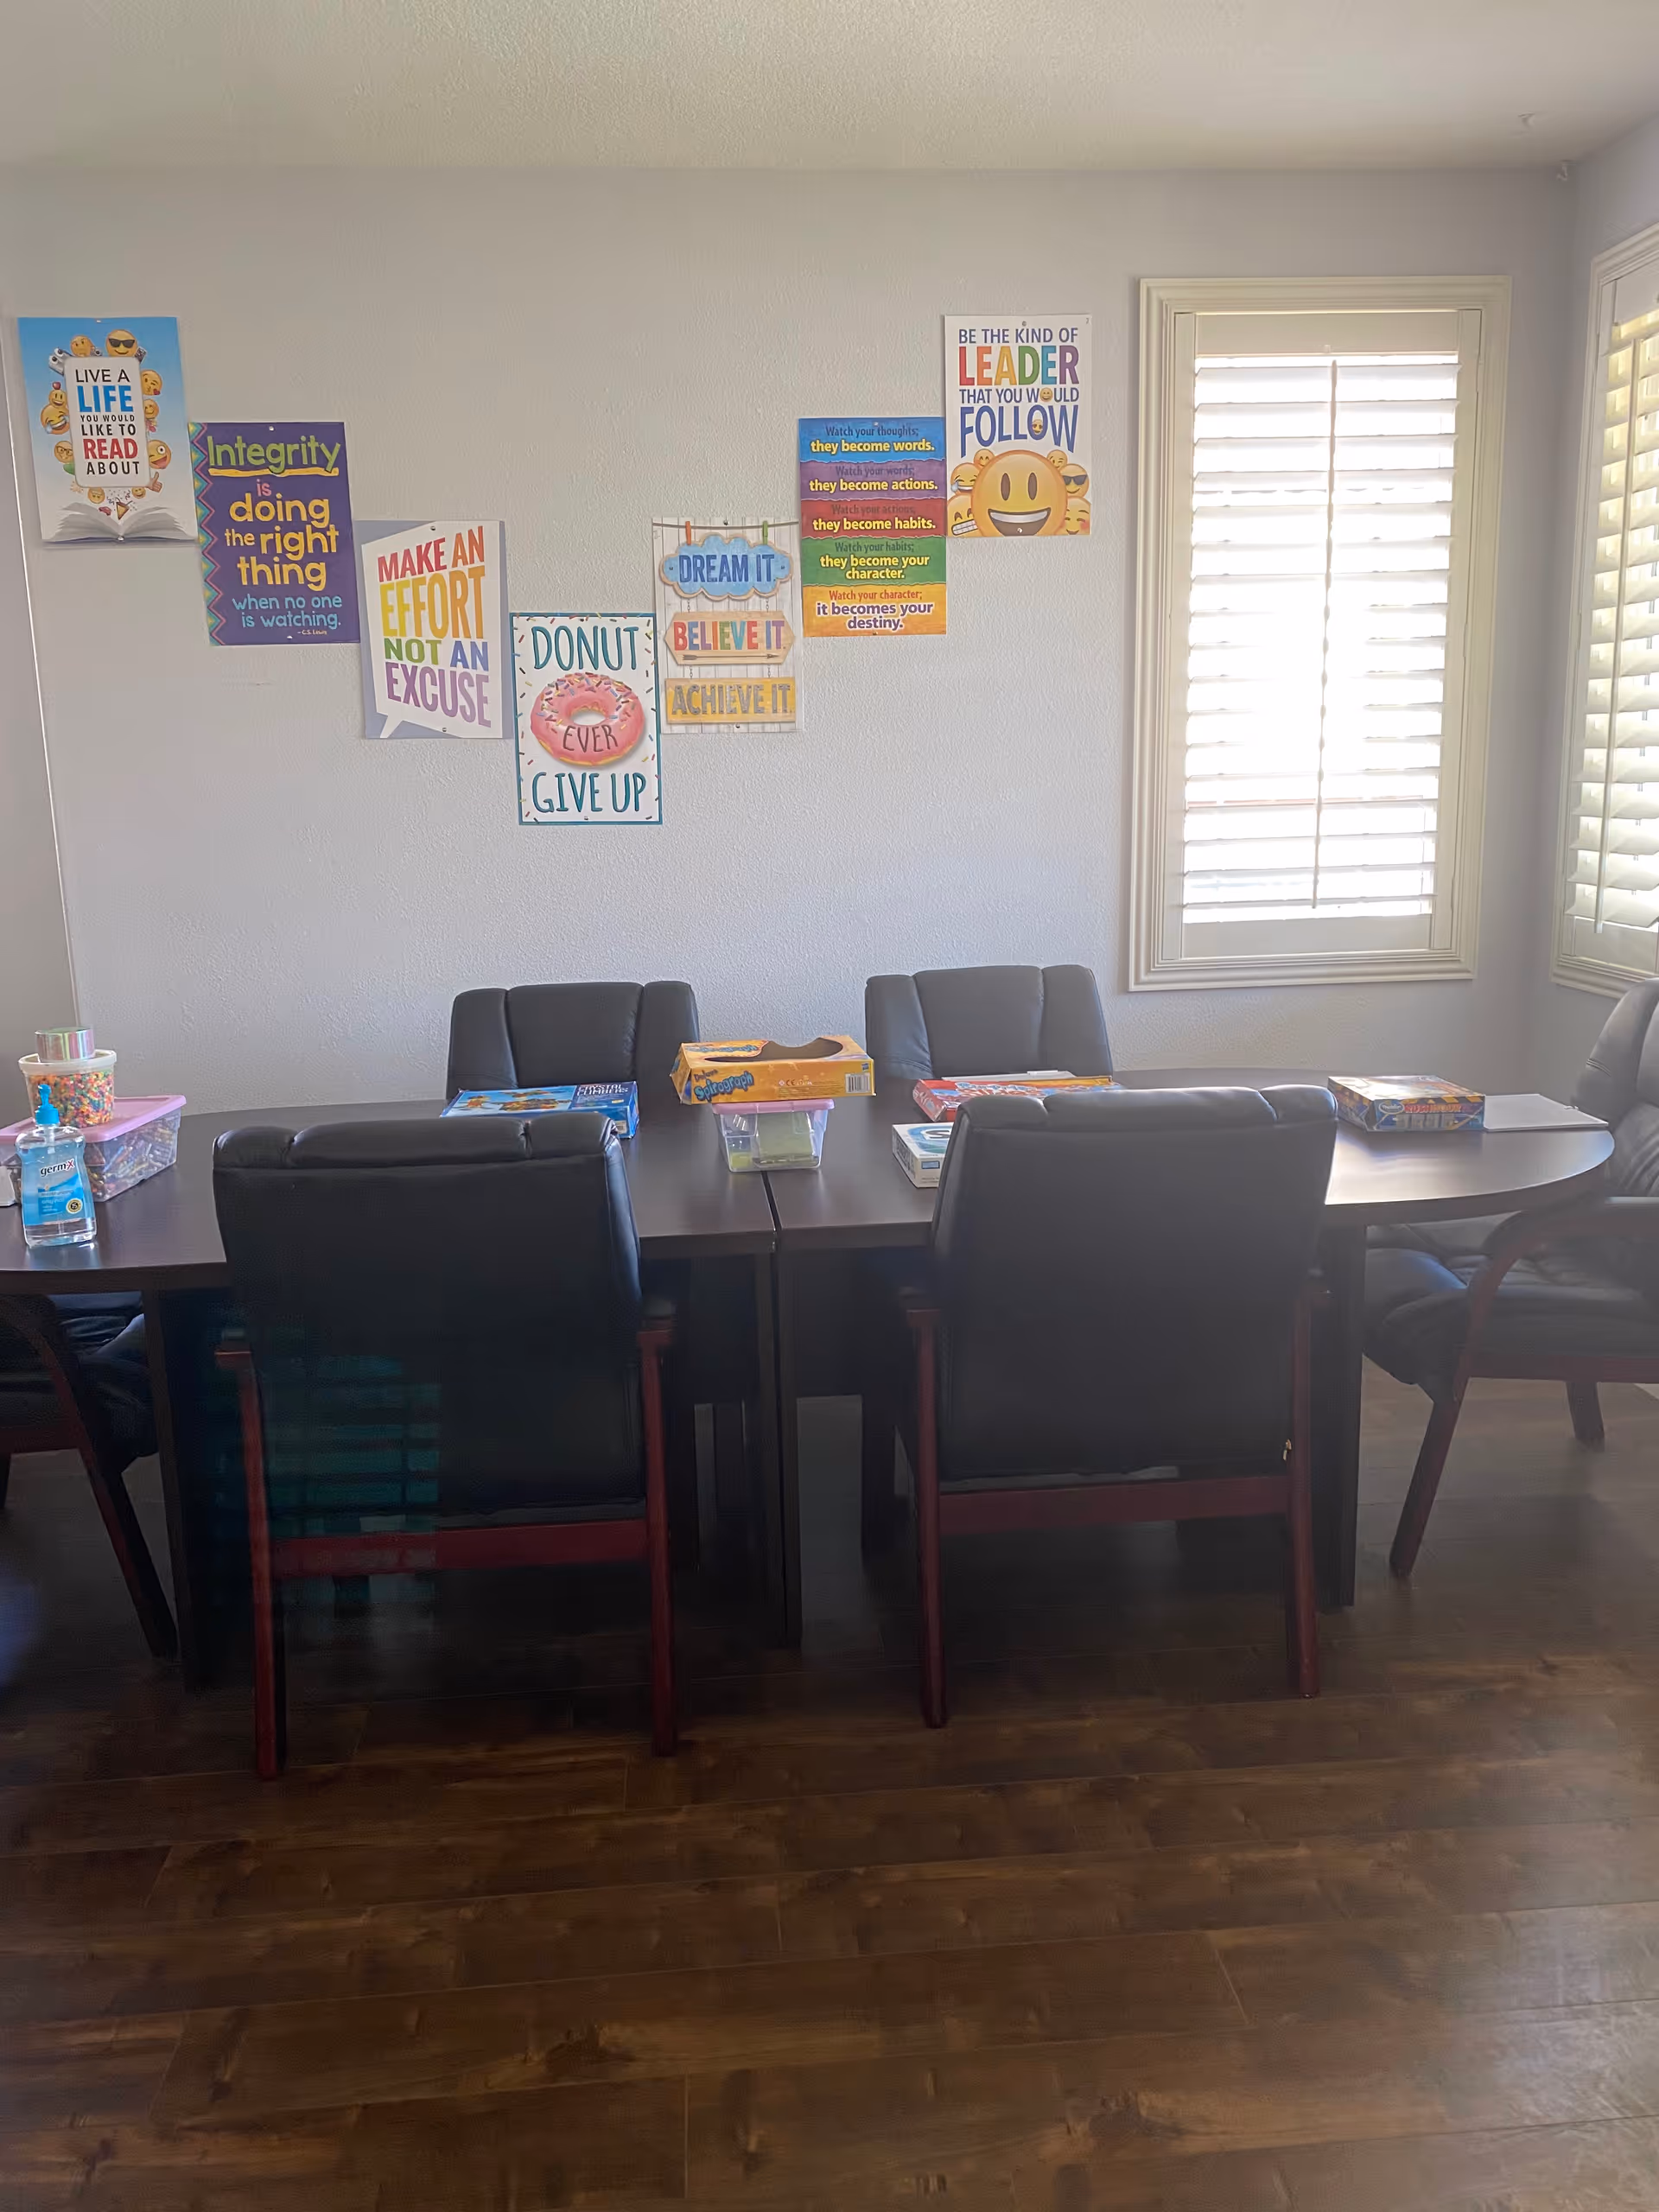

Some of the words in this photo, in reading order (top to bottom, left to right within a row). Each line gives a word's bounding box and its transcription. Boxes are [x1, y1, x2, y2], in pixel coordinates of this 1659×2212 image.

[958, 328, 976, 344] BE
[981, 328, 1009, 344] THE
[1015, 327, 1053, 344] KIND
[1058, 327, 1079, 343] OF
[75, 369, 111, 383] LIVE
[118, 369, 130, 383] A
[958, 345, 1080, 386] LEADER
[76, 385, 135, 414] LIFE
[959, 389, 993, 404] THAT
[996, 388, 1022, 404] YOU
[81, 424, 114, 436] LIKE
[118, 424, 137, 435] TO
[825, 426, 854, 437] Watch
[855, 428, 876, 439] your
[877, 426, 919, 438] thoughts;
[960, 404, 1079, 459] FOLLOW
[83, 437, 139, 460] READ
[207, 435, 341, 474] Integrity
[810, 441, 839, 455] they
[842, 441, 890, 452] become
[893, 439, 935, 452] words.
[86, 461, 140, 475] ABOUT
[836, 465, 863, 476] Watch
[864, 467, 884, 479] your
[255, 479, 273, 498] is
[809, 480, 837, 494] they
[840, 479, 889, 492] become
[891, 479, 938, 491] actions.
[229, 493, 331, 529] doing
[831, 504, 861, 515] Watch
[861, 506, 880, 518] your
[813, 518, 841, 533] they
[843, 518, 892, 530] become
[894, 518, 937, 530] habits.
[225, 529, 256, 547] the
[259, 524, 340, 561] right
[835, 542, 862, 553] Watch
[864, 543, 884, 555] your
[886, 542, 915, 552] habits;
[378, 537, 447, 583] MAKE
[451, 525, 486, 568] AN
[820, 556, 848, 570] they
[850, 556, 899, 567] become
[901, 556, 930, 570] your
[237, 556, 327, 592] thing
[678, 554, 750, 583] DREAM
[845, 568, 906, 580] character.
[232, 594, 280, 612] when
[285, 596, 306, 610] no
[311, 595, 343, 609] one
[379, 565, 486, 640] EFFORT
[829, 590, 856, 601] Watch
[858, 592, 878, 603] your
[880, 590, 923, 601] character;
[241, 612, 256, 628] is
[260, 609, 341, 630] watching.
[817, 603, 829, 616] it
[831, 602, 897, 616] becomes
[899, 603, 934, 617] your
[848, 616, 904, 631] destiny.
[673, 620, 759, 652] BELIEVE
[383, 639, 442, 665] NOT
[450, 641, 489, 672] AN
[531, 626, 639, 671] DONUT
[385, 662, 492, 728] EXCUSE
[671, 684, 765, 715] ACHIEVE
[563, 724, 619, 753] EVER
[532, 772, 603, 814] GIVE
[610, 772, 646, 814] UP
[694, 1071, 755, 1103] Spirograph
